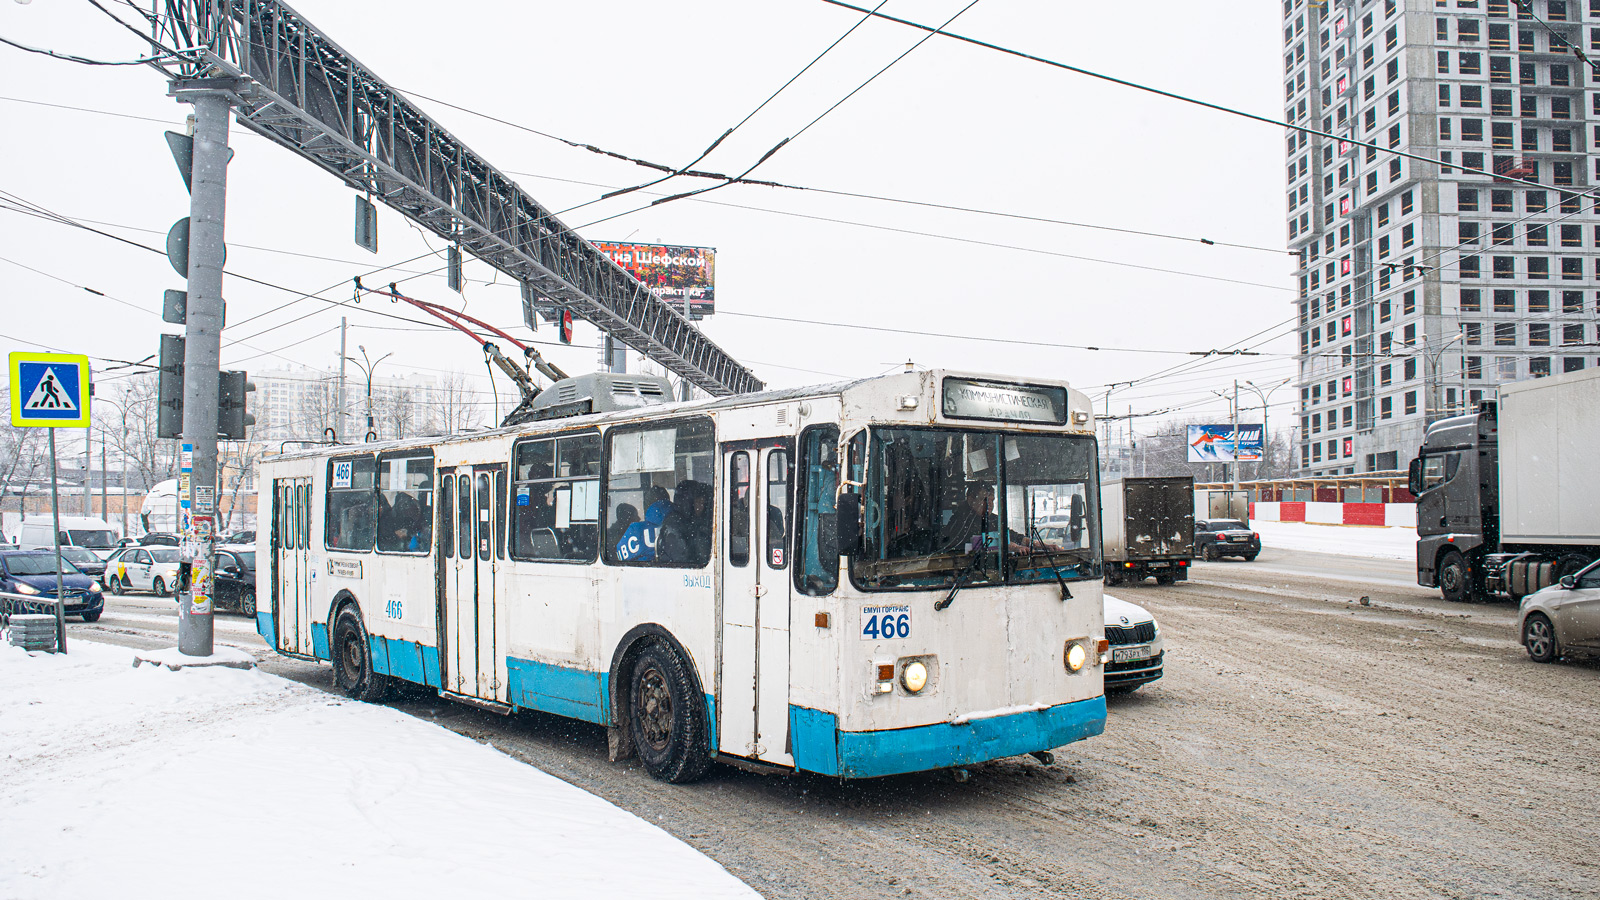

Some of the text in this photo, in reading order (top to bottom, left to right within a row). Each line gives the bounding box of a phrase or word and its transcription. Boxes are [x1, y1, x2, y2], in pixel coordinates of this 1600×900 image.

[1338, 80, 1346, 93] 14
[1341, 201, 1348, 214] 10
[615, 251, 705, 268] на Шефской
[336, 463, 349, 480] 466
[683, 574, 711, 589] ВЫХОД
[385, 599, 403, 620] 466
[882, 605, 909, 613] ГОРТРАНС
[863, 614, 910, 639] 466
